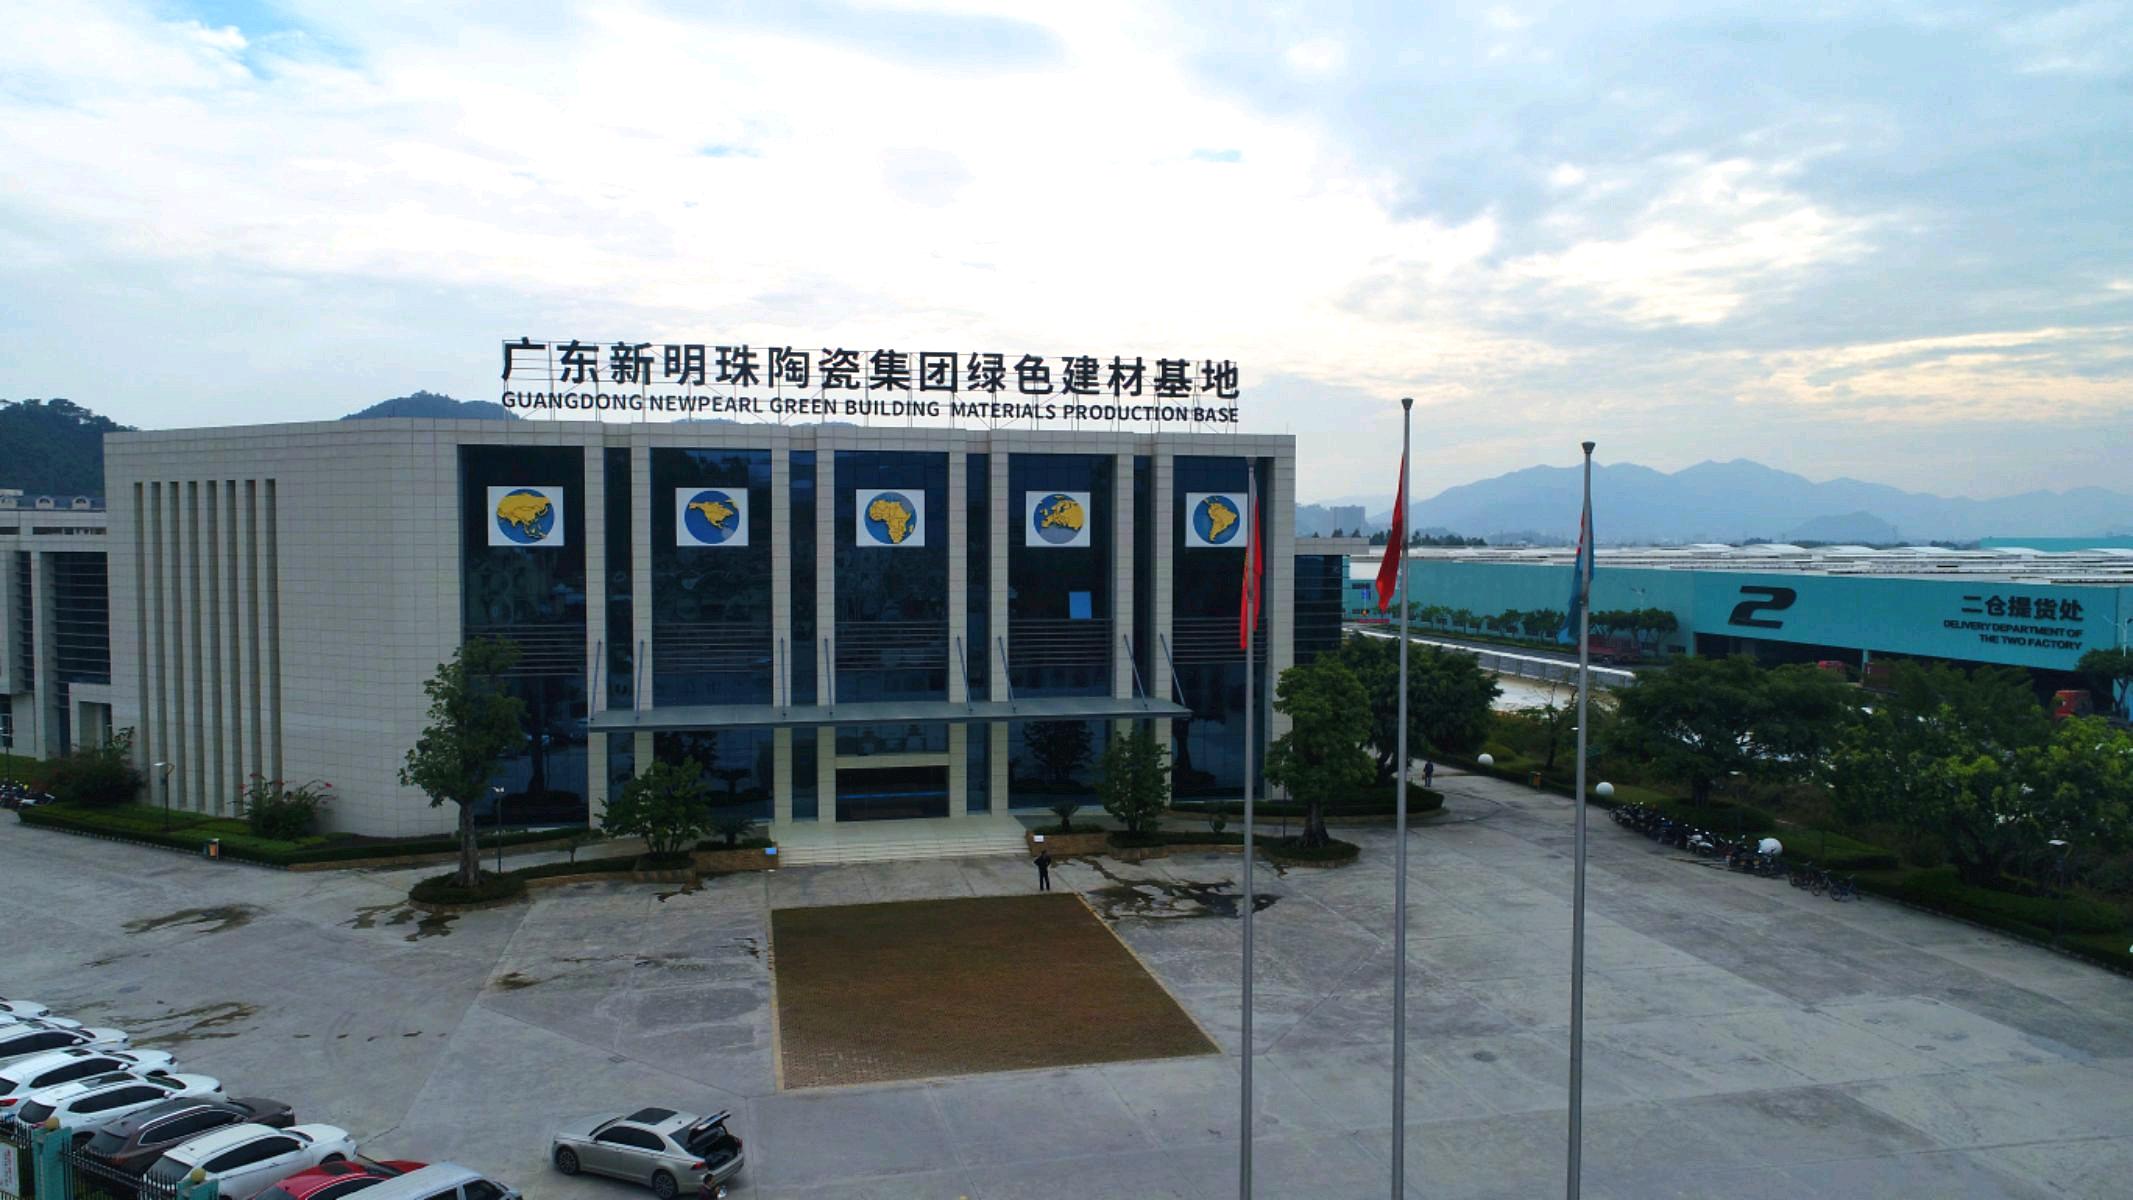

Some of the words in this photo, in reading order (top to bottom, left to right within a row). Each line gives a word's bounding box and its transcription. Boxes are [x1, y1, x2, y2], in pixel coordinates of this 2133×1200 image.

[501, 336, 1240, 399] 广东新明珠陶瓷集团绿色建材基地
[501, 391, 643, 410] GUANGDONG
[650, 394, 763, 414] NEWPEARL
[769, 397, 837, 415] GREEN
[845, 400, 940, 417] BUILDING
[951, 402, 1056, 420] MATERIALS
[1063, 404, 1189, 422] PRODUCTION
[1193, 406, 1239, 423] BASE
[1727, 585, 1797, 629] 2
[1944, 620, 1990, 631] DELIVERY
[1992, 623, 2065, 636] DEPARTMENT
[2066, 629, 2084, 638] OF
[1979, 634, 1999, 643] THE
[2001, 635, 2026, 646] TWO
[2027, 638, 2083, 650] FACTORY
